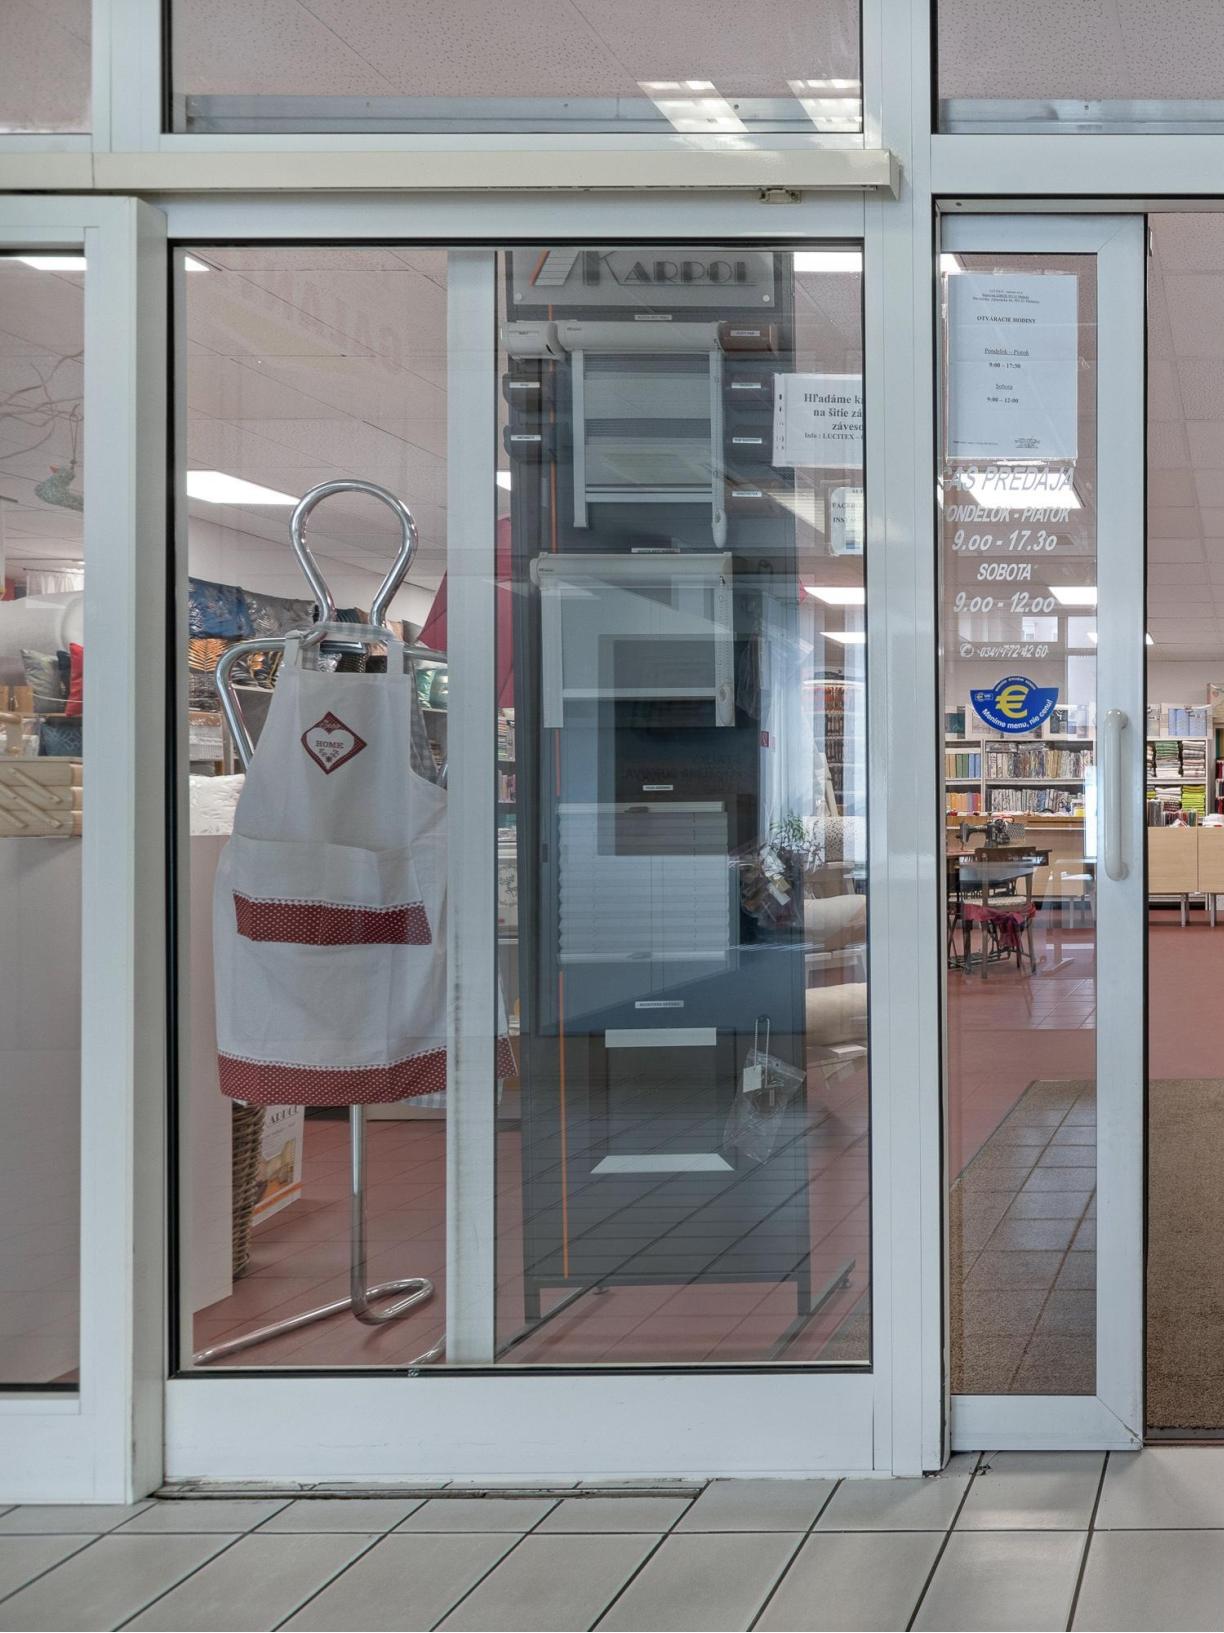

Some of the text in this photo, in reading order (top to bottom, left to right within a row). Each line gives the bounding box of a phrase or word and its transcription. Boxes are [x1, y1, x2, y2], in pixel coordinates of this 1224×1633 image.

[804, 393, 852, 405] Hľadáme
[813, 409, 826, 417] na
[828, 407, 848, 418] šitie
[981, 466, 1074, 491] PREDAJA
[1021, 505, 1071, 522] PIATOK
[977, 563, 1033, 581] SOBOTA
[315, 740, 345, 749] HOME
